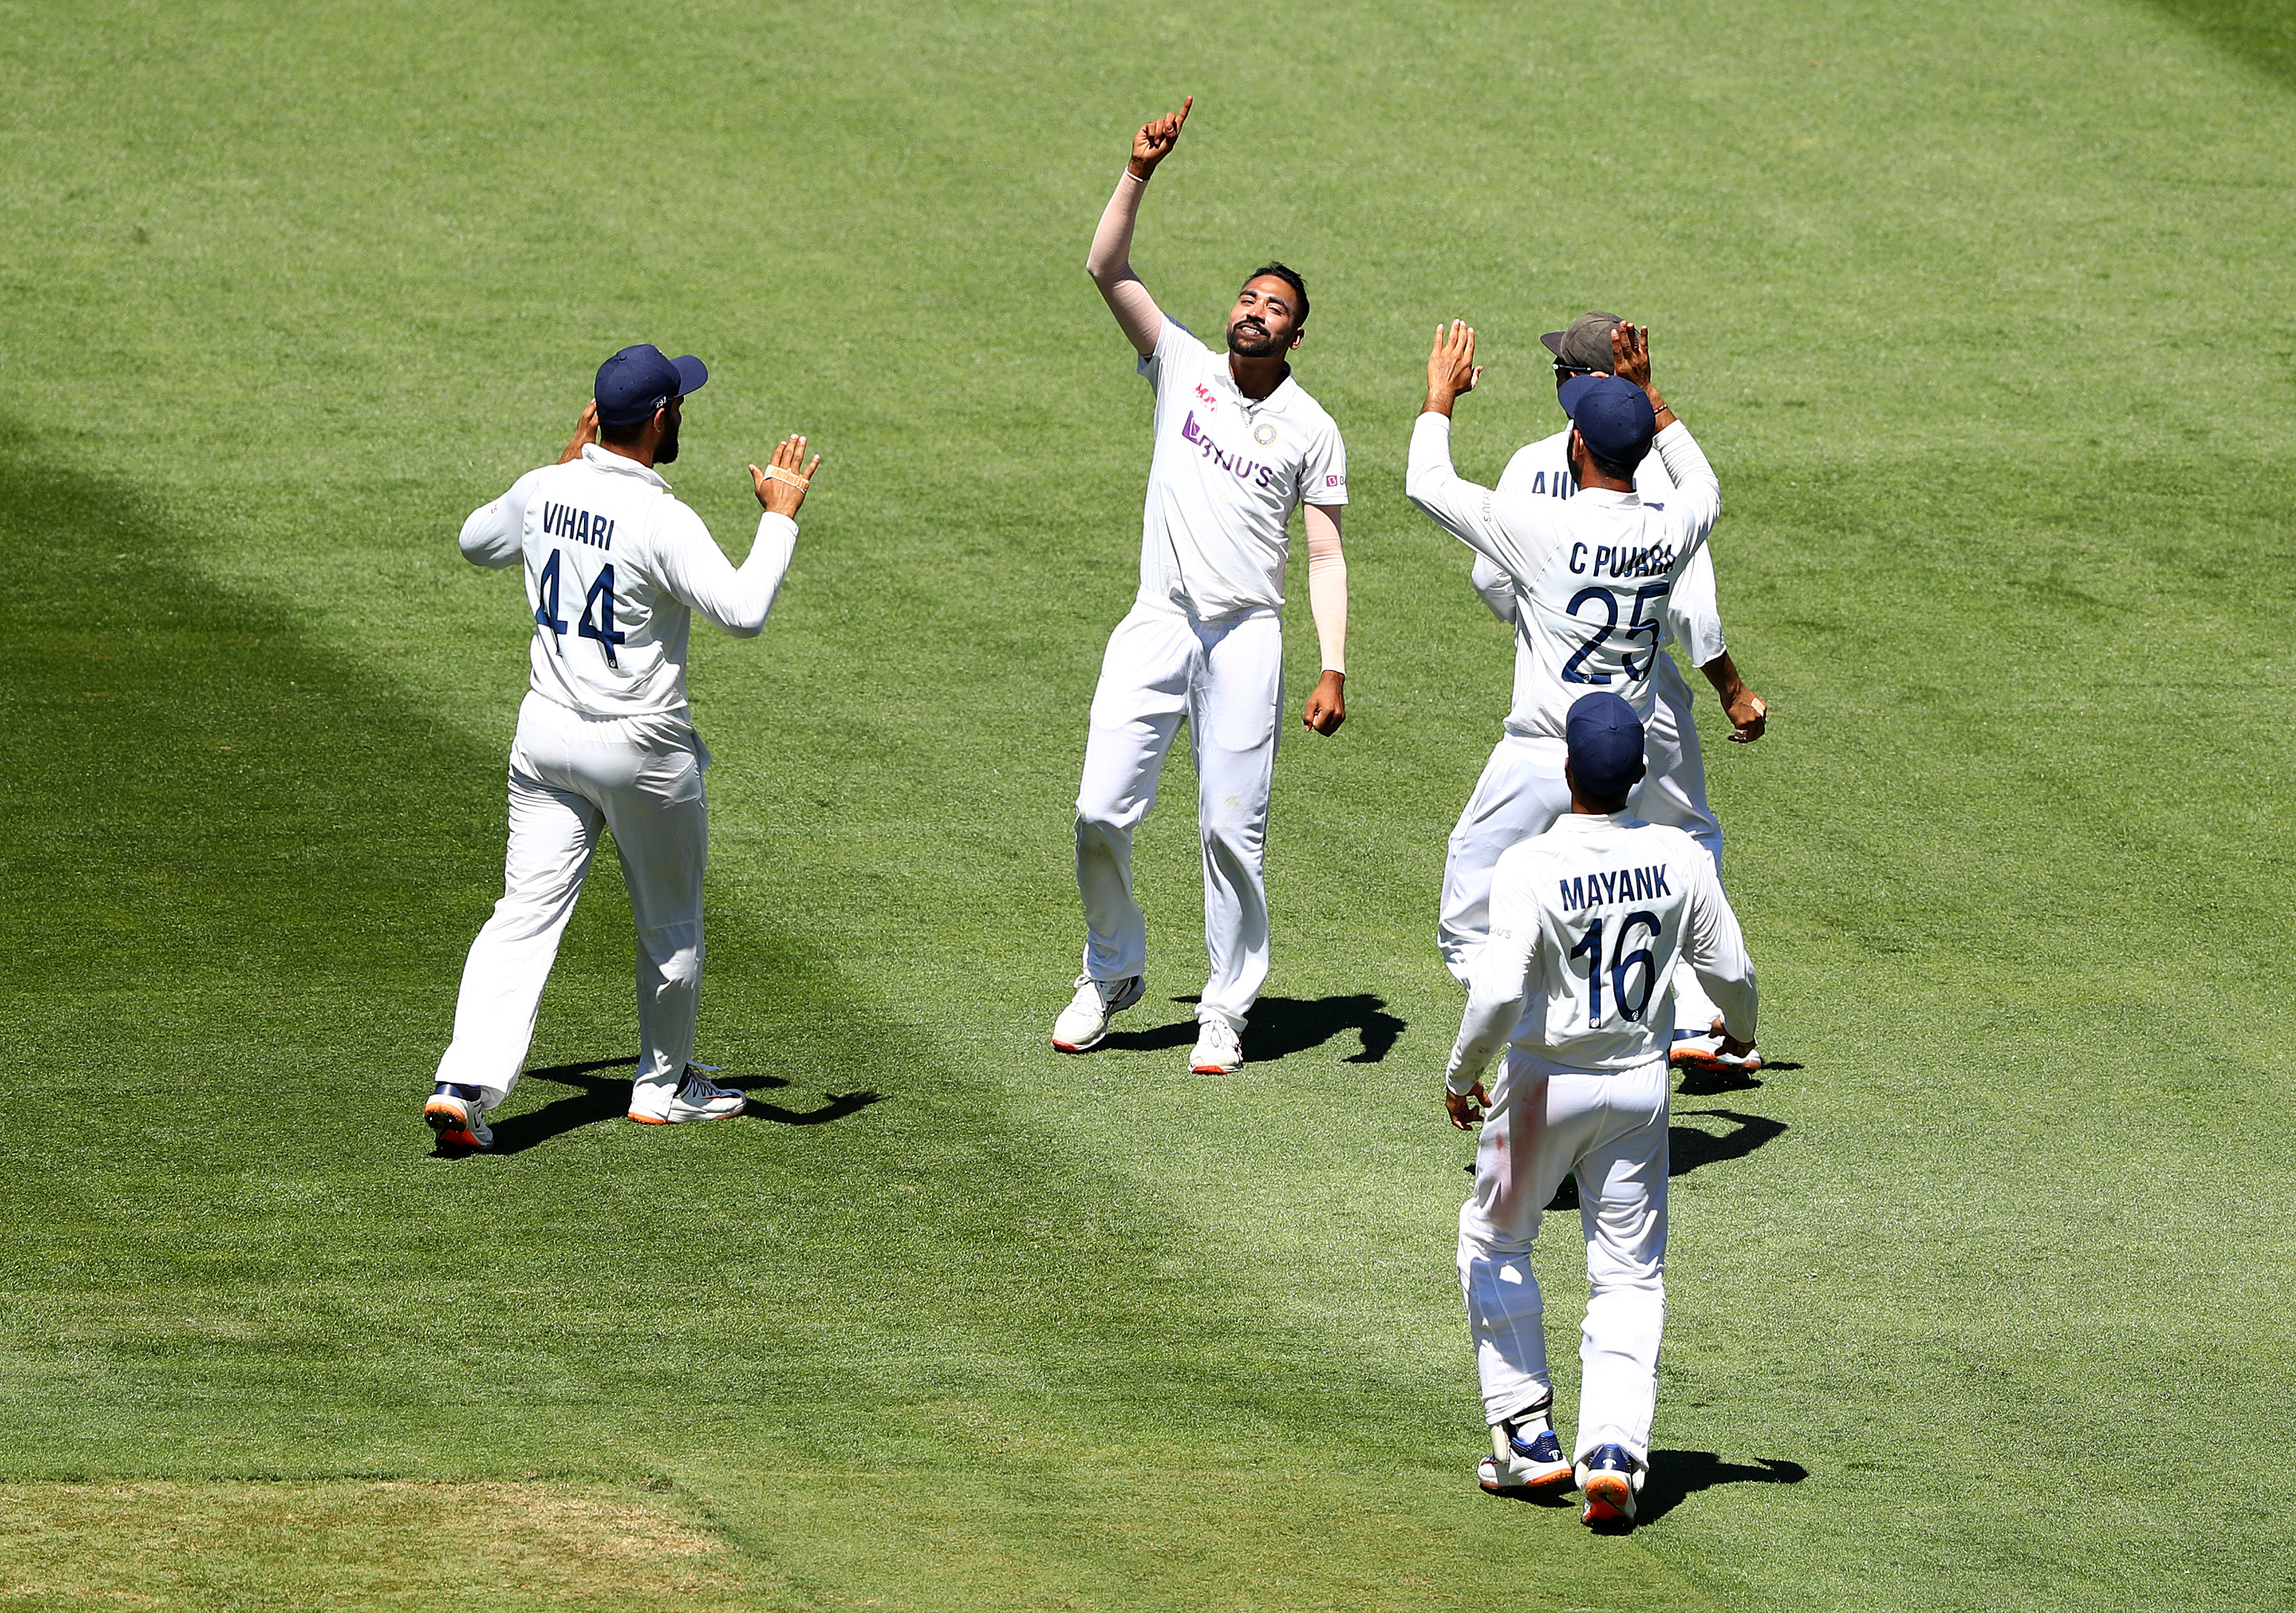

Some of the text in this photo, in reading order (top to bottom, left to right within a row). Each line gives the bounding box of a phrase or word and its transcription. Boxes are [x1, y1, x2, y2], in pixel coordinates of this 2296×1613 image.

[1199, 435, 1273, 487] BYJU'S
[544, 501, 614, 550] VIHARI
[1569, 542, 1676, 578] C PUJARA
[536, 548, 625, 669] 44
[1561, 582, 1670, 684] 25
[1560, 864, 1671, 911] MAYANK
[1570, 911, 1662, 1028] 16
